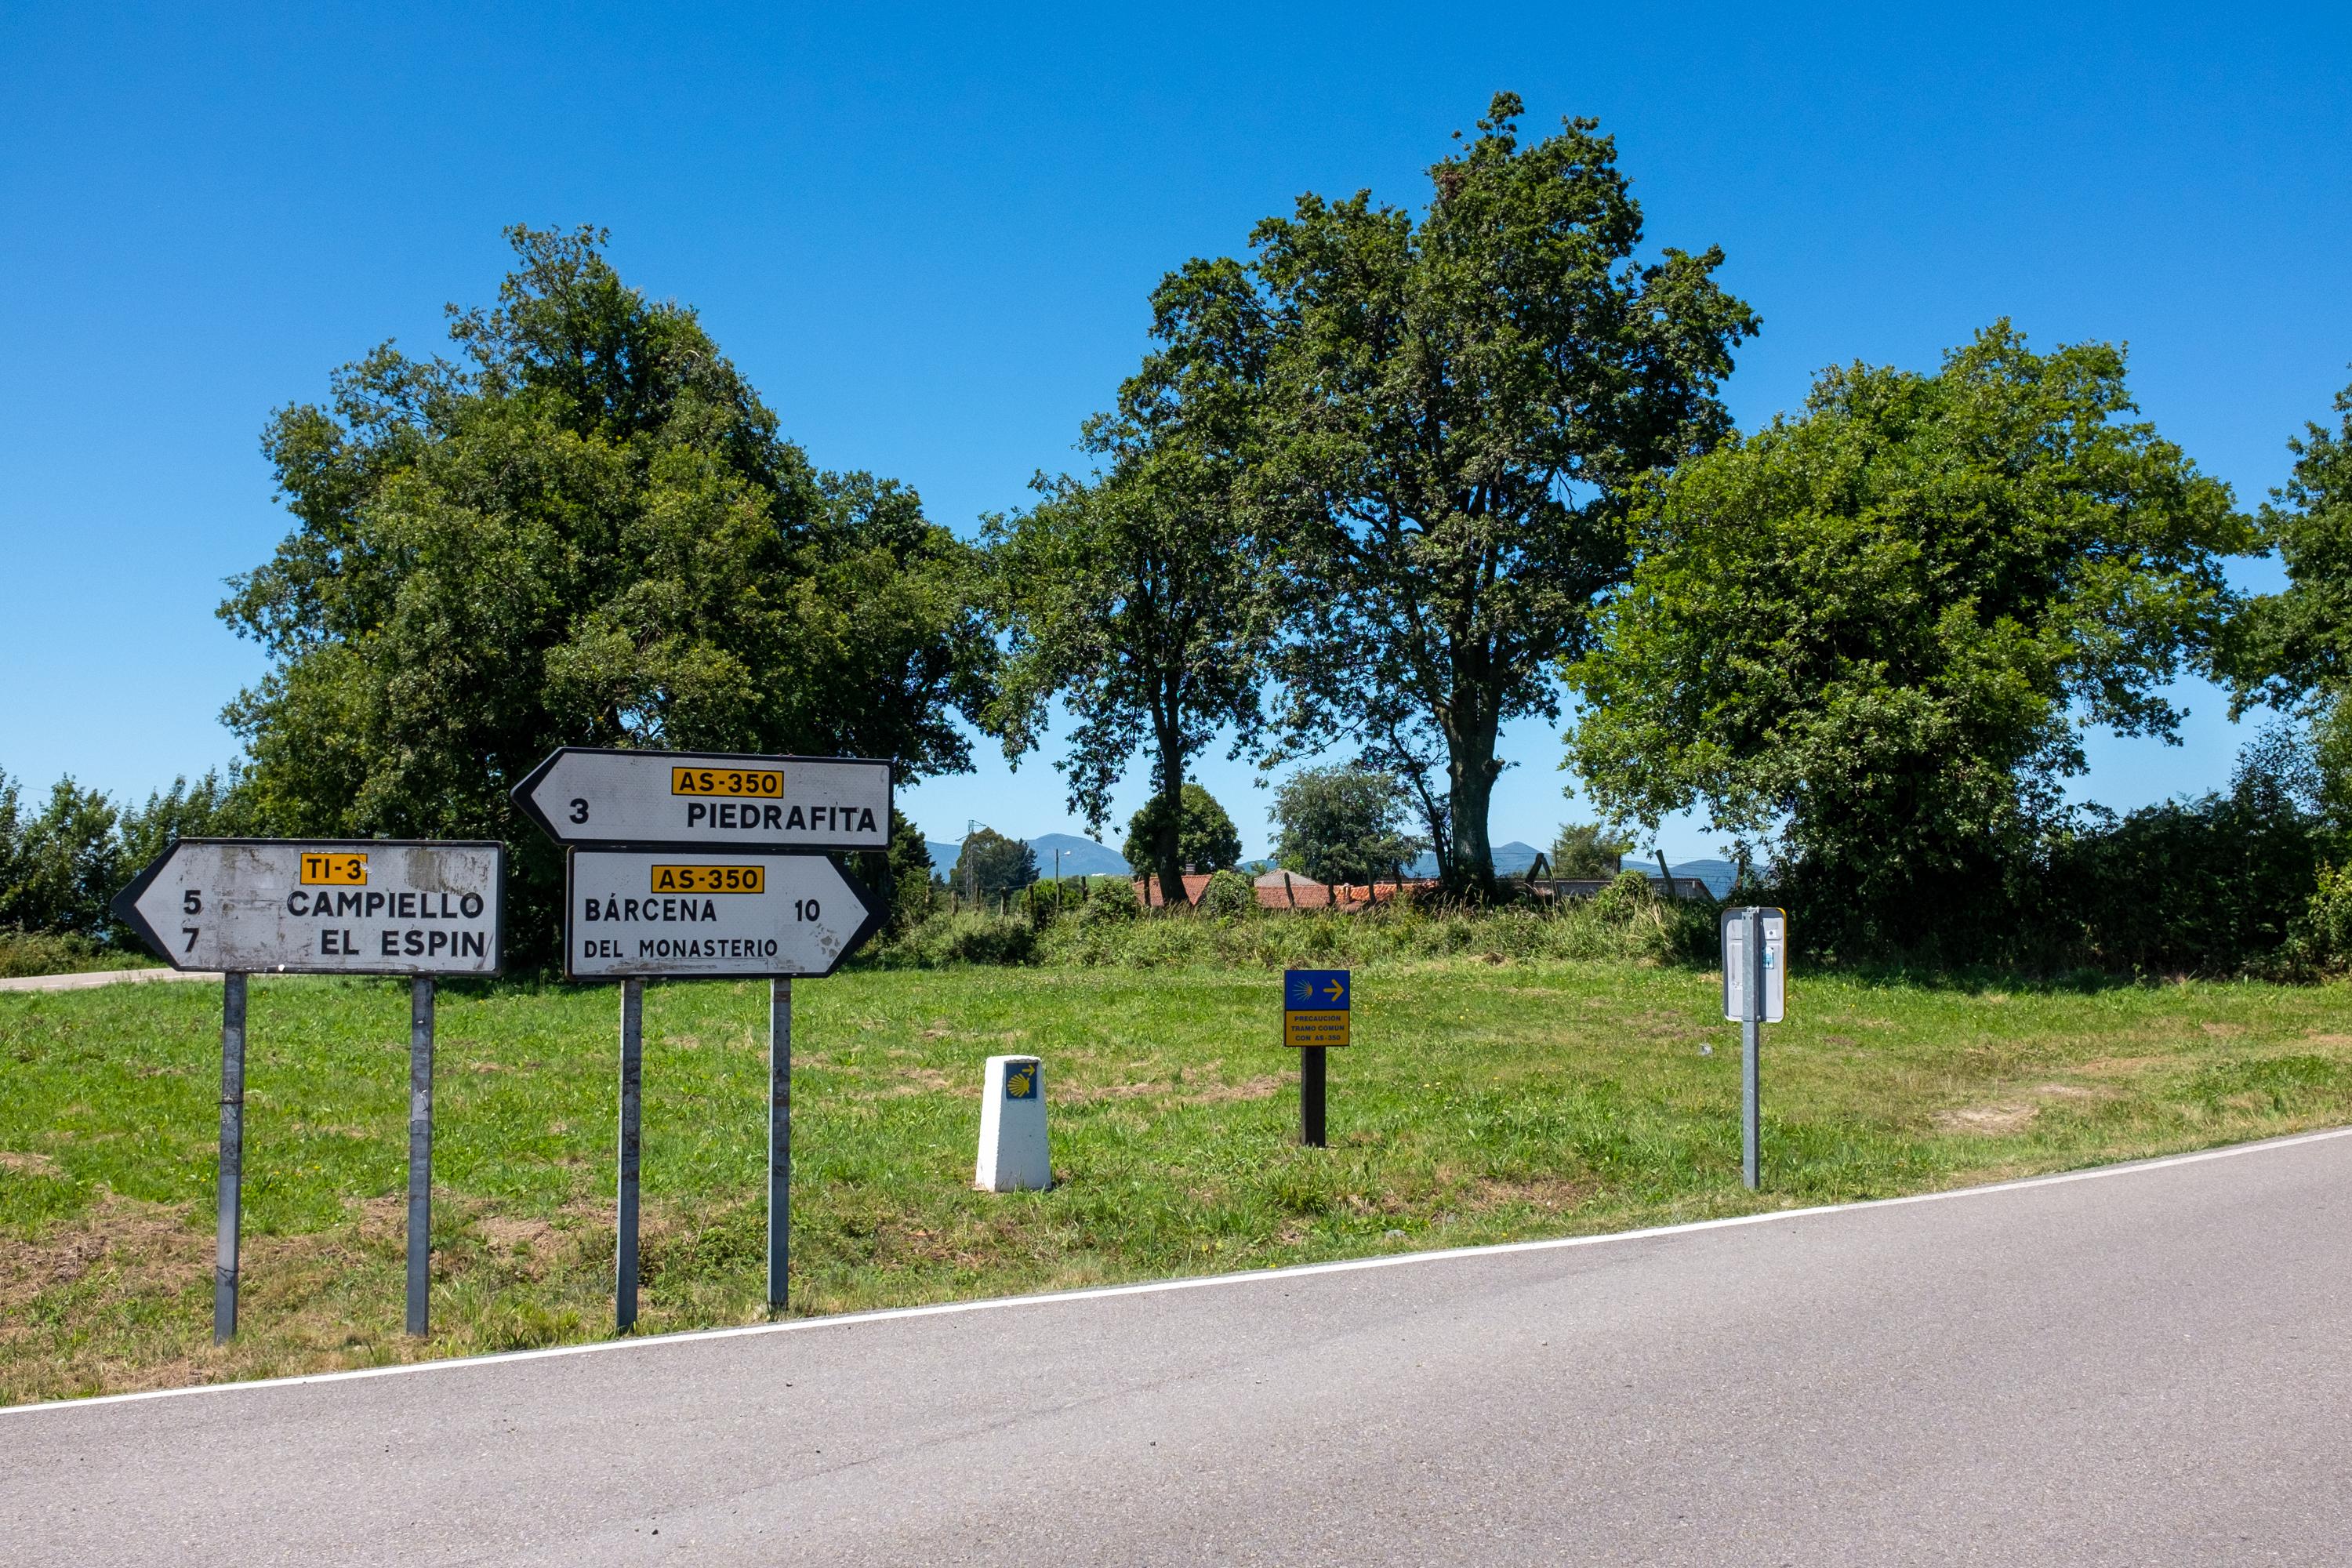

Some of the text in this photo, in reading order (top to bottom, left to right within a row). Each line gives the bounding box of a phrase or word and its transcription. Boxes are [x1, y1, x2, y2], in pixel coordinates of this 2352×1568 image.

[679, 771, 777, 794] AS-350
[569, 798, 877, 833] 3 PIEDRAFITA
[307, 858, 361, 879] TI-3
[659, 869, 758, 890] AS-350
[183, 889, 485, 919] 5 CAMPIELLO
[585, 893, 821, 922] BÁRCENA 10
[182, 927, 485, 957] 7 EL ESPIN
[584, 939, 778, 958] DEL MONASTERIO
